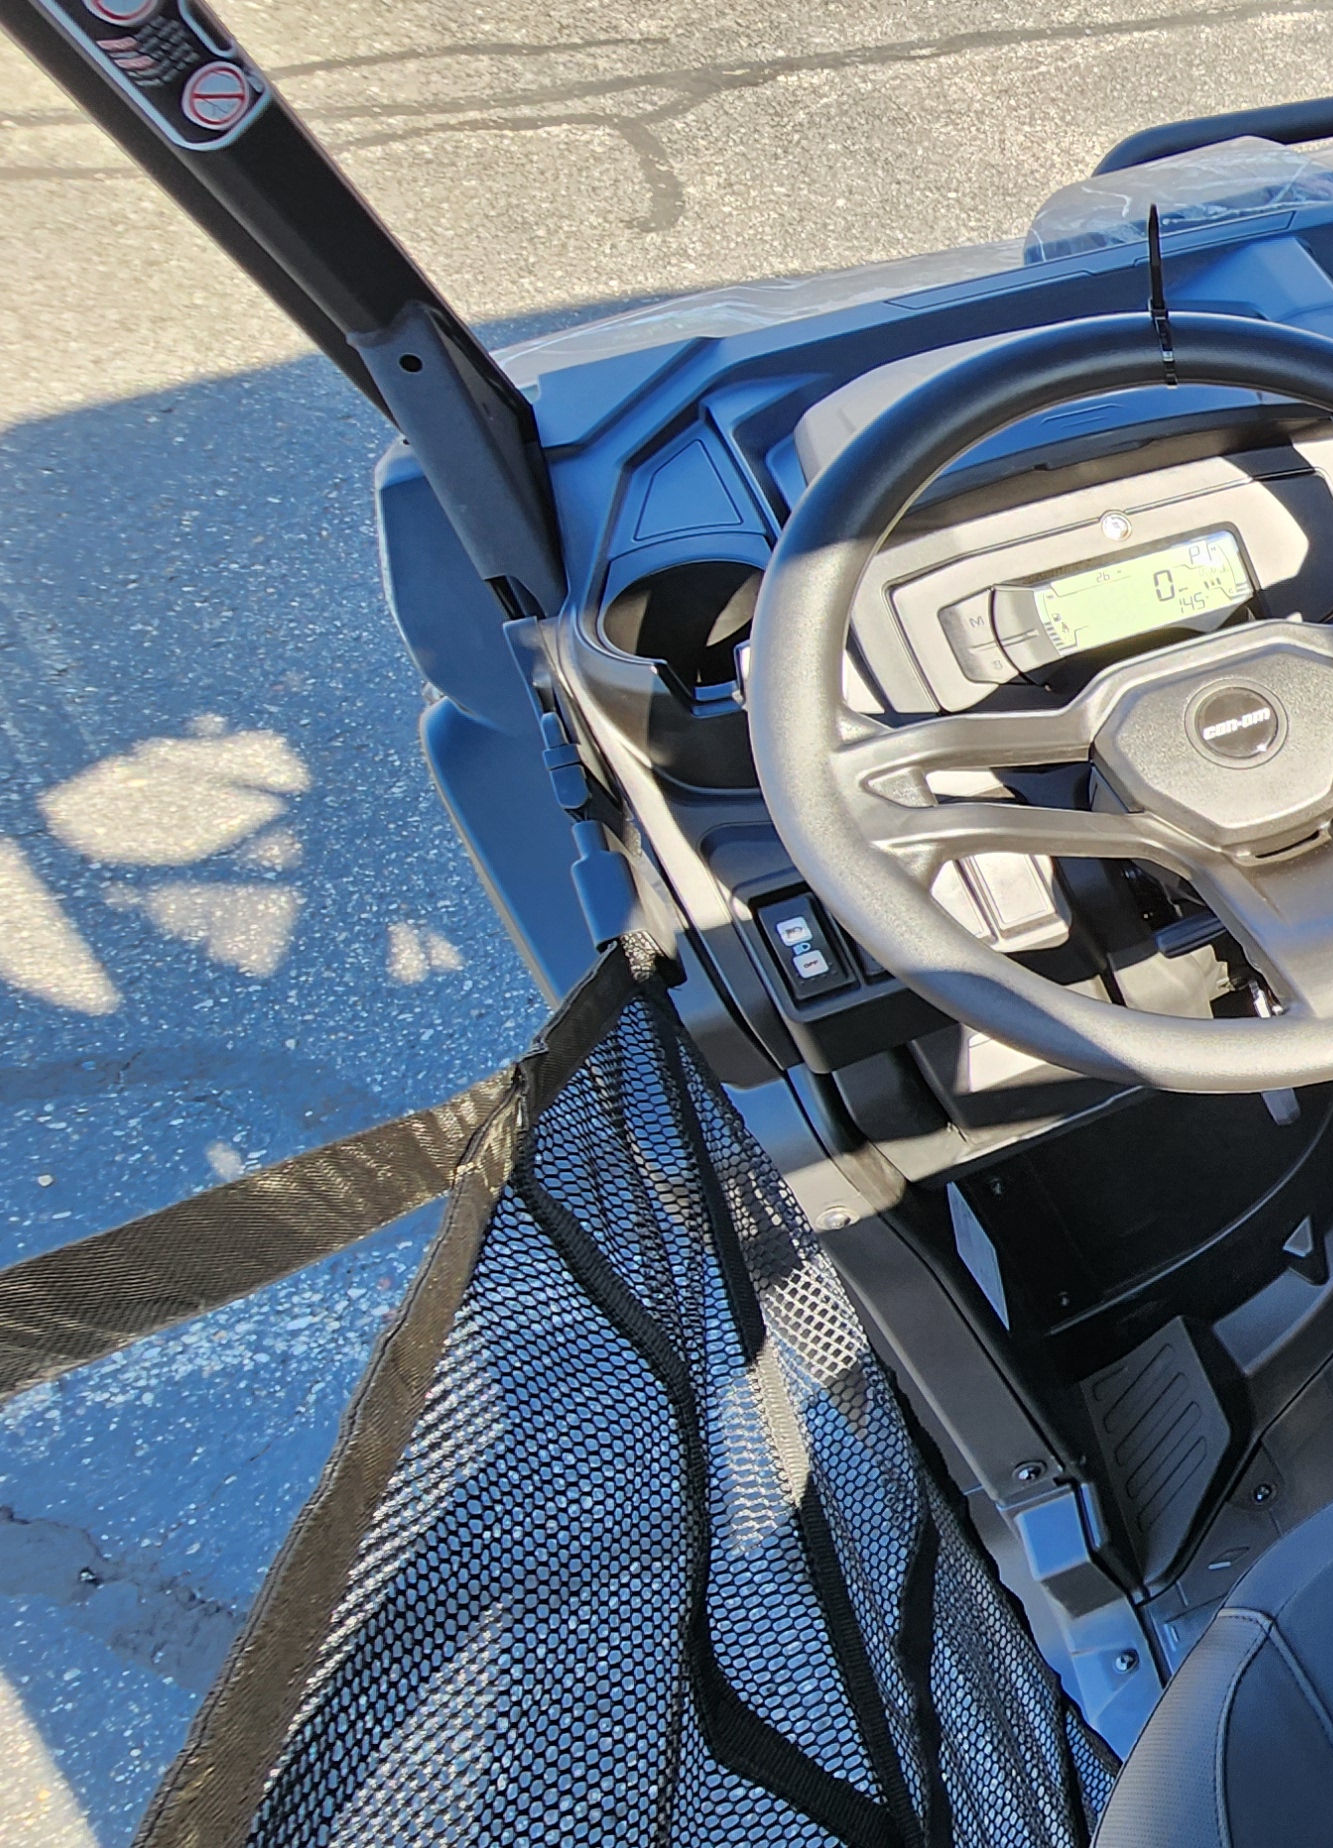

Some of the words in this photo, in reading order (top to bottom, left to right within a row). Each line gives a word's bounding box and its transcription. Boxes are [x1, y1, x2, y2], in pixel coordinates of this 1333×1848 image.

[1189, 546, 1200, 565] P
[1153, 569, 1175, 602] 0
[969, 615, 985, 628] M
[1203, 707, 1270, 740] can-am
